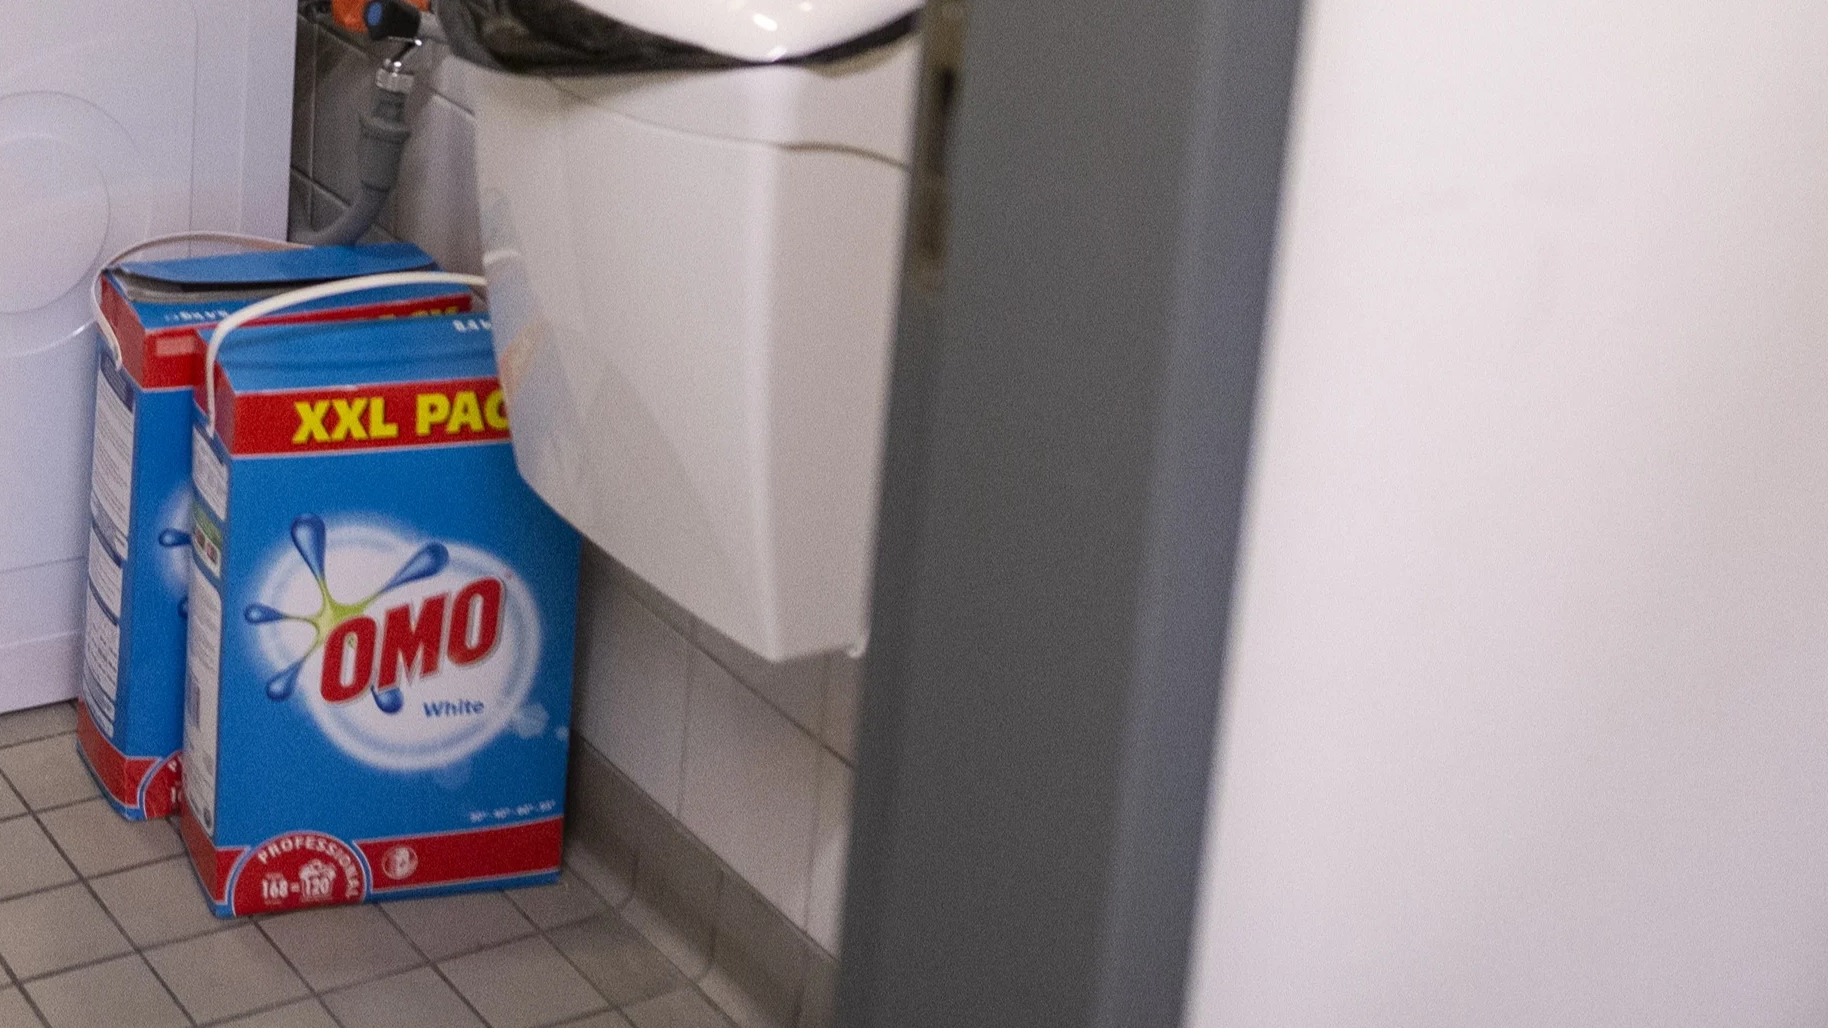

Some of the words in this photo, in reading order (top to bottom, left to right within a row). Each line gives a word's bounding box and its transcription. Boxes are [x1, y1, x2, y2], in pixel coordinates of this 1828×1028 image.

[292, 397, 399, 444] XXL
[415, 387, 510, 436] PAC
[320, 576, 506, 703] OMO
[423, 699, 485, 718] White
[257, 835, 360, 900] PROFESSIONAL
[262, 878, 289, 900] 168
